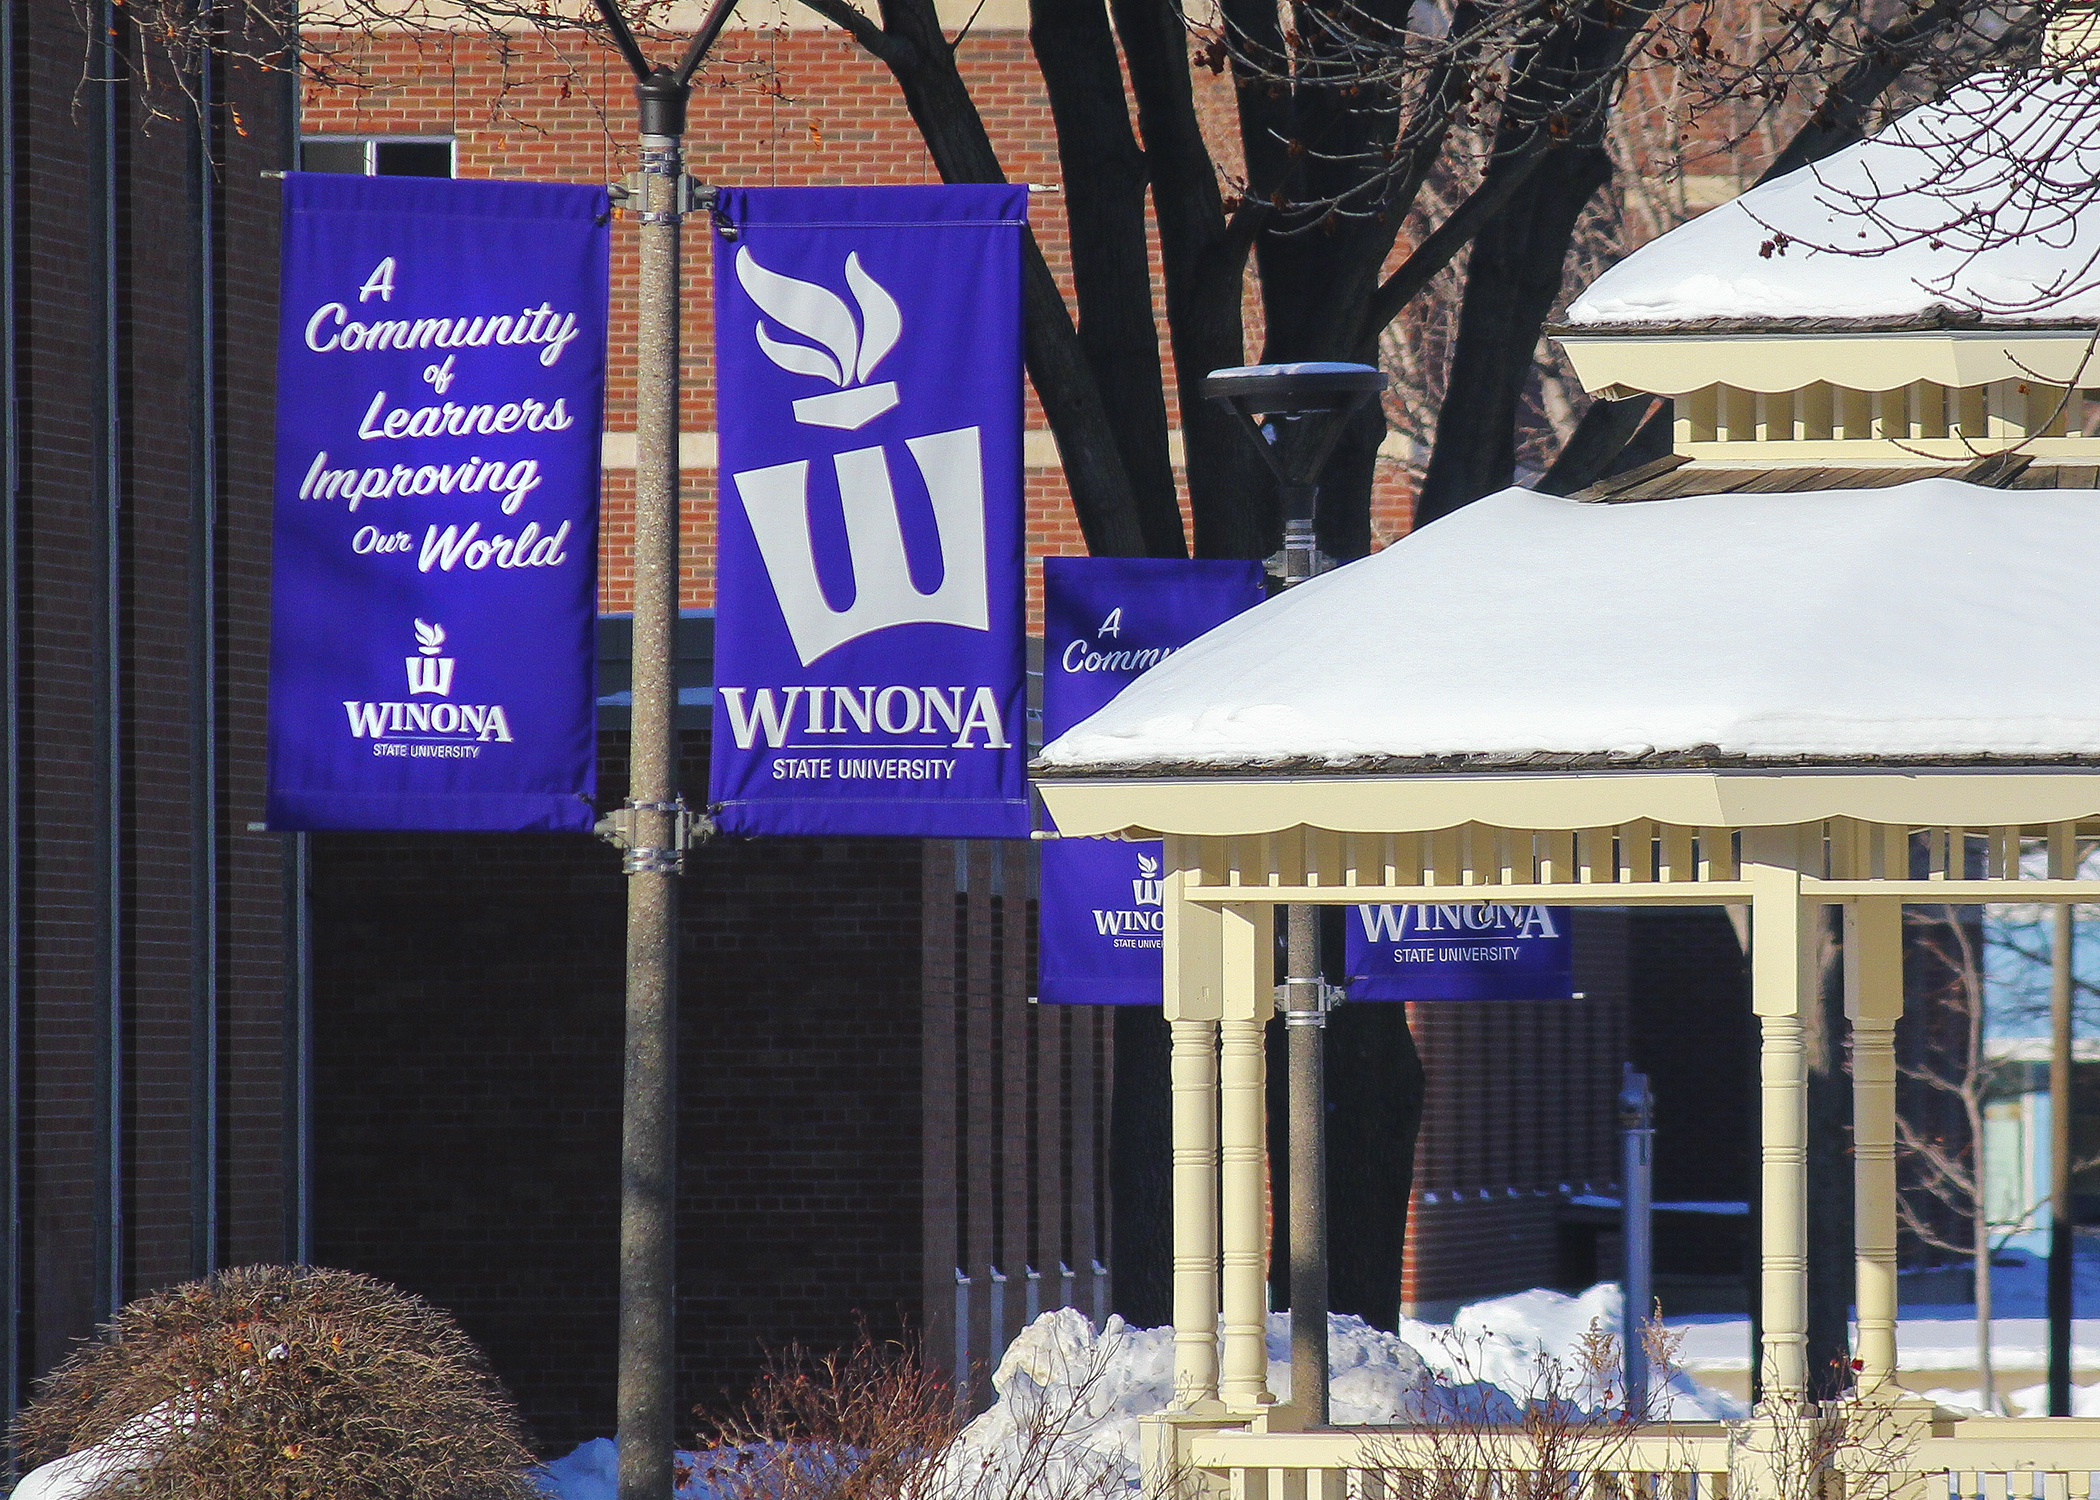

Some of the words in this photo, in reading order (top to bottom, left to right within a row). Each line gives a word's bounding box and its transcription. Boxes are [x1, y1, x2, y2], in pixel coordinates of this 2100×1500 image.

[359, 257, 395, 302] A
[305, 302, 579, 366] Community
[423, 354, 455, 394] of
[358, 391, 574, 439] Learners
[299, 451, 542, 515] Improving
[353, 526, 412, 554] Our
[418, 520, 569, 572] World
[1098, 607, 1121, 638] A
[343, 701, 513, 742] WINONA
[719, 686, 1012, 749] WINONA
[373, 744, 407, 757] STATE
[411, 745, 479, 758] UNIVERSITY
[773, 759, 831, 779] STATE
[839, 759, 955, 779] UNIVERSITY
[1358, 904, 1559, 942] WINONA
[1113, 939, 1136, 948] STATE
[1394, 948, 1434, 962] STATE
[1439, 947, 1519, 961] UNIVERSITY
